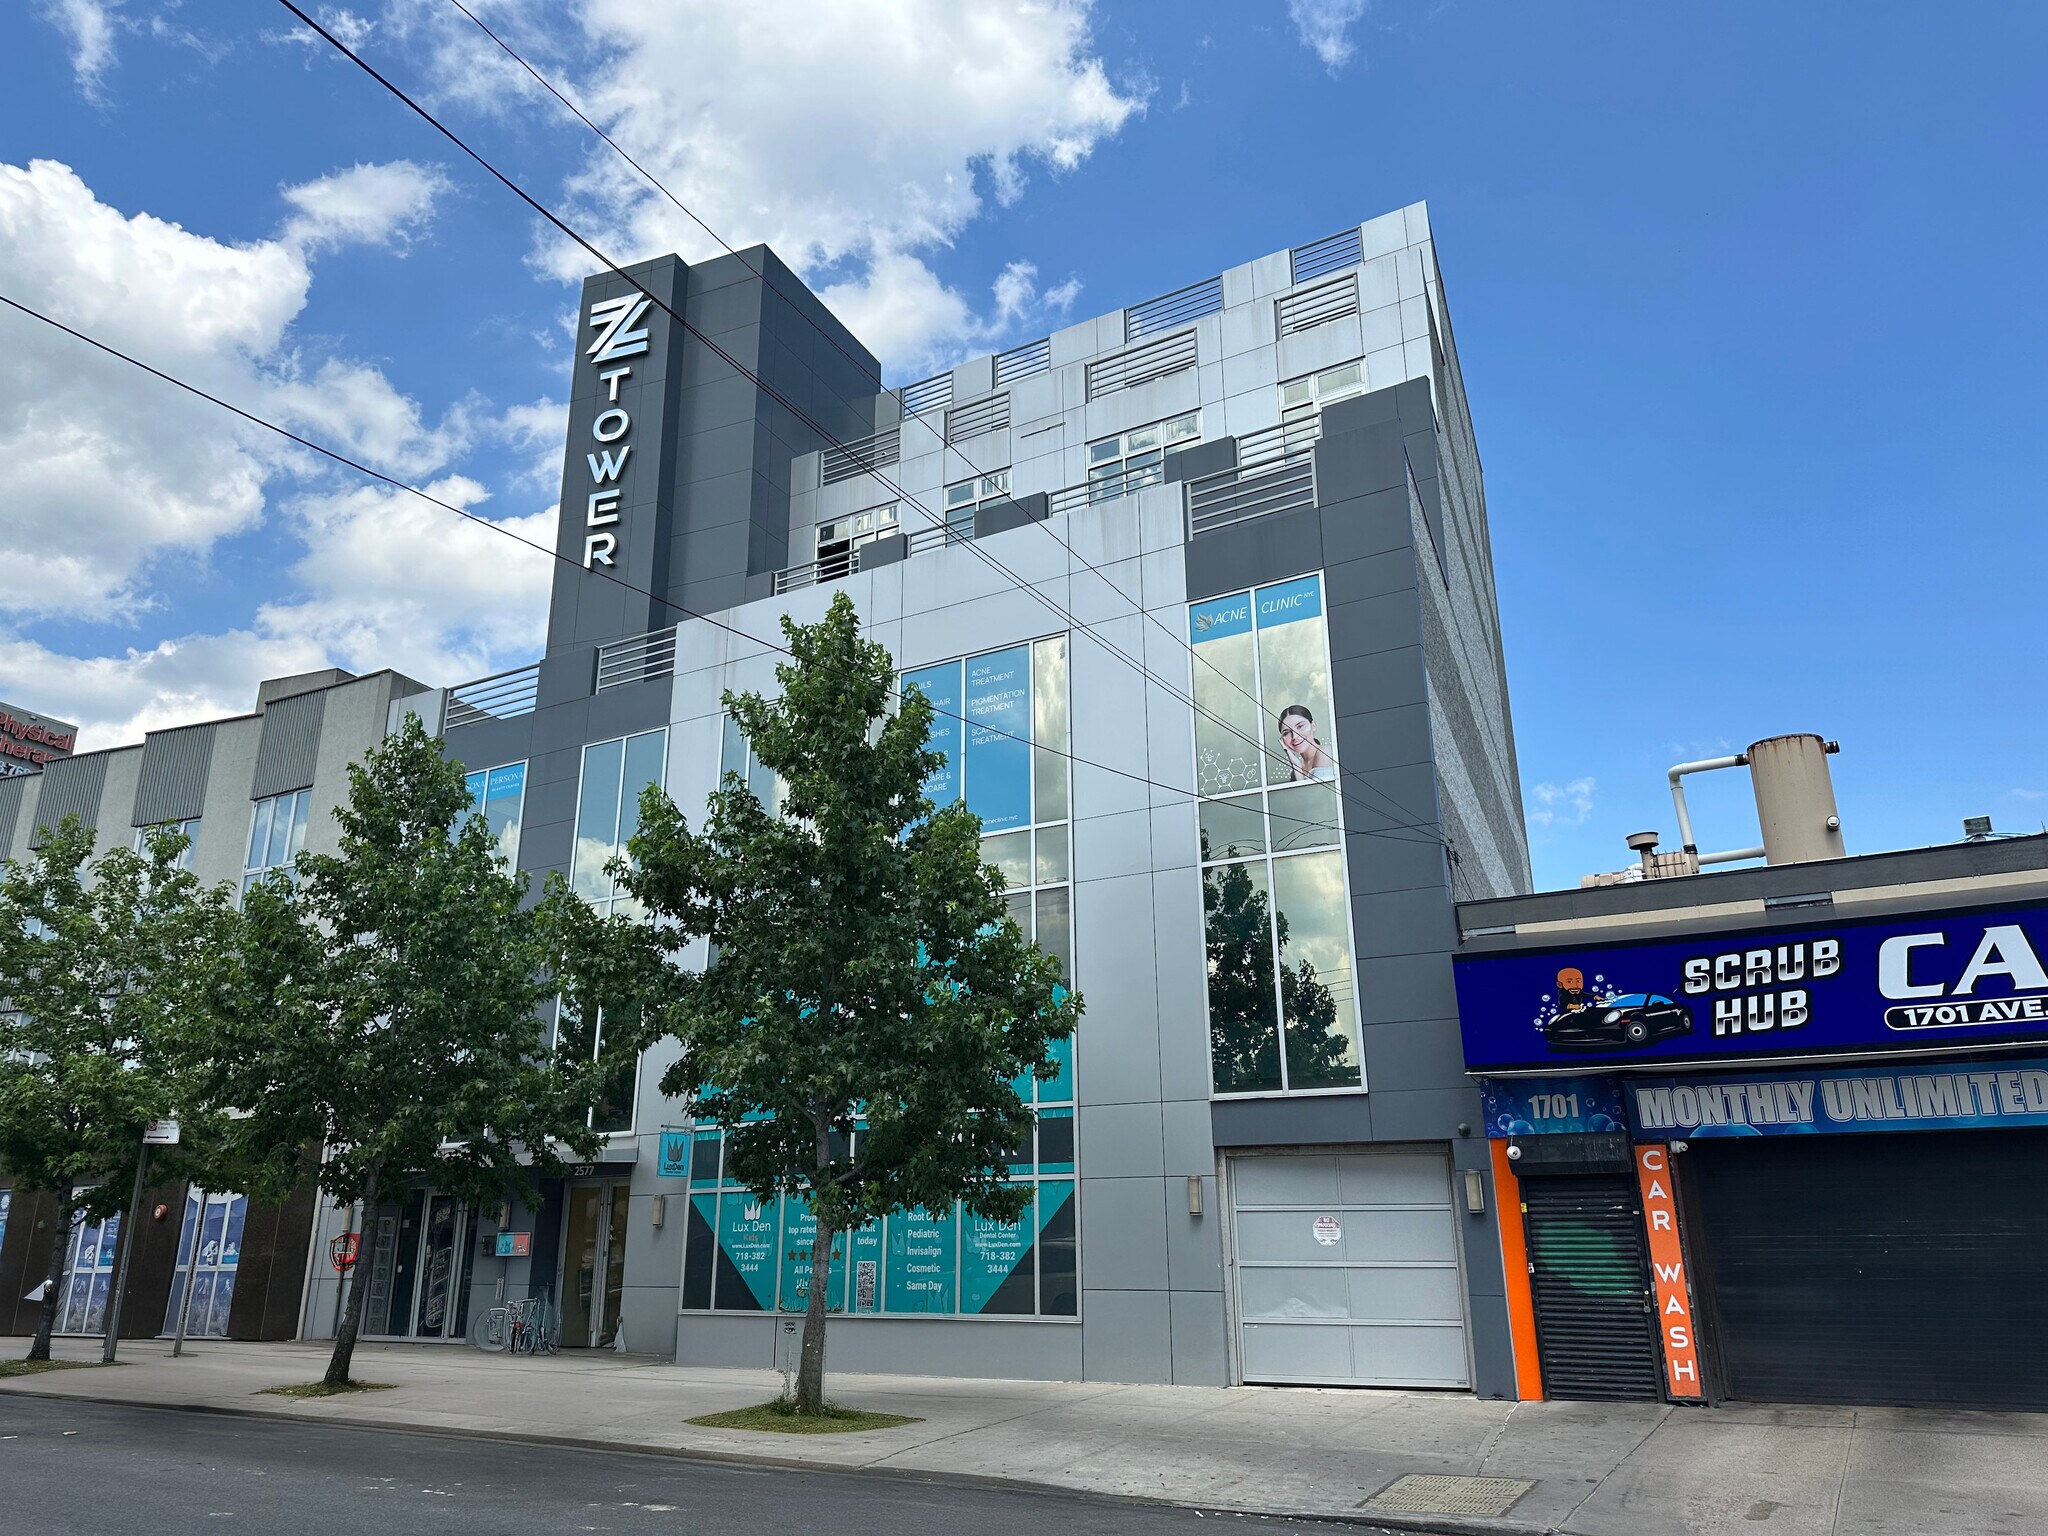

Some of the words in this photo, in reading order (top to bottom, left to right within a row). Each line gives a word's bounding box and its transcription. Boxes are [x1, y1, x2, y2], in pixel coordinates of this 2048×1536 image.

[583, 367, 632, 569] TOWER
[1214, 607, 1248, 625] ACNE
[1261, 594, 1303, 614] CLINIC
[971, 667, 991, 678] ACNE
[971, 671, 1014, 687] TREATMENT
[933, 698, 951, 707] HAIR
[971, 688, 1025, 707] PIGMENTATION
[971, 701, 1014, 716] TREATMENT
[971, 730, 1014, 746] TREATMENT
[1685, 939, 1840, 994] SCRUB
[1715, 989, 1808, 1035] HUB
[1903, 1004, 1970, 1026] 1701
[1636, 1081, 1815, 1130] MONTHLY
[1821, 1069, 2048, 1122] UNLIMITED
[1528, 1093, 1579, 1120] 1701
[574, 1166, 595, 1176] 2577
[1642, 1150, 1671, 1231] CAR
[908, 1212, 925, 1221] Root
[732, 1221, 749, 1232] Lux
[752, 1221, 771, 1231] Den
[788, 1226, 799, 1236] top
[800, 1225, 817, 1234] rated
[860, 1223, 876, 1232] visit
[975, 1220, 994, 1232] Lux
[907, 1229, 940, 1239] Pediatric
[796, 1237, 814, 1246] since
[857, 1236, 878, 1247] today
[735, 1252, 766, 1261] 718-382
[906, 1246, 942, 1257] Invisalign
[980, 1251, 1016, 1261] 718-382
[741, 1263, 759, 1272] 3444
[794, 1265, 804, 1274] All
[906, 1263, 941, 1273] Cosmetic
[987, 1264, 1009, 1273] 3444
[906, 1281, 927, 1290] Same
[928, 1281, 943, 1292] Day
[1654, 1263, 1696, 1382] WASH
